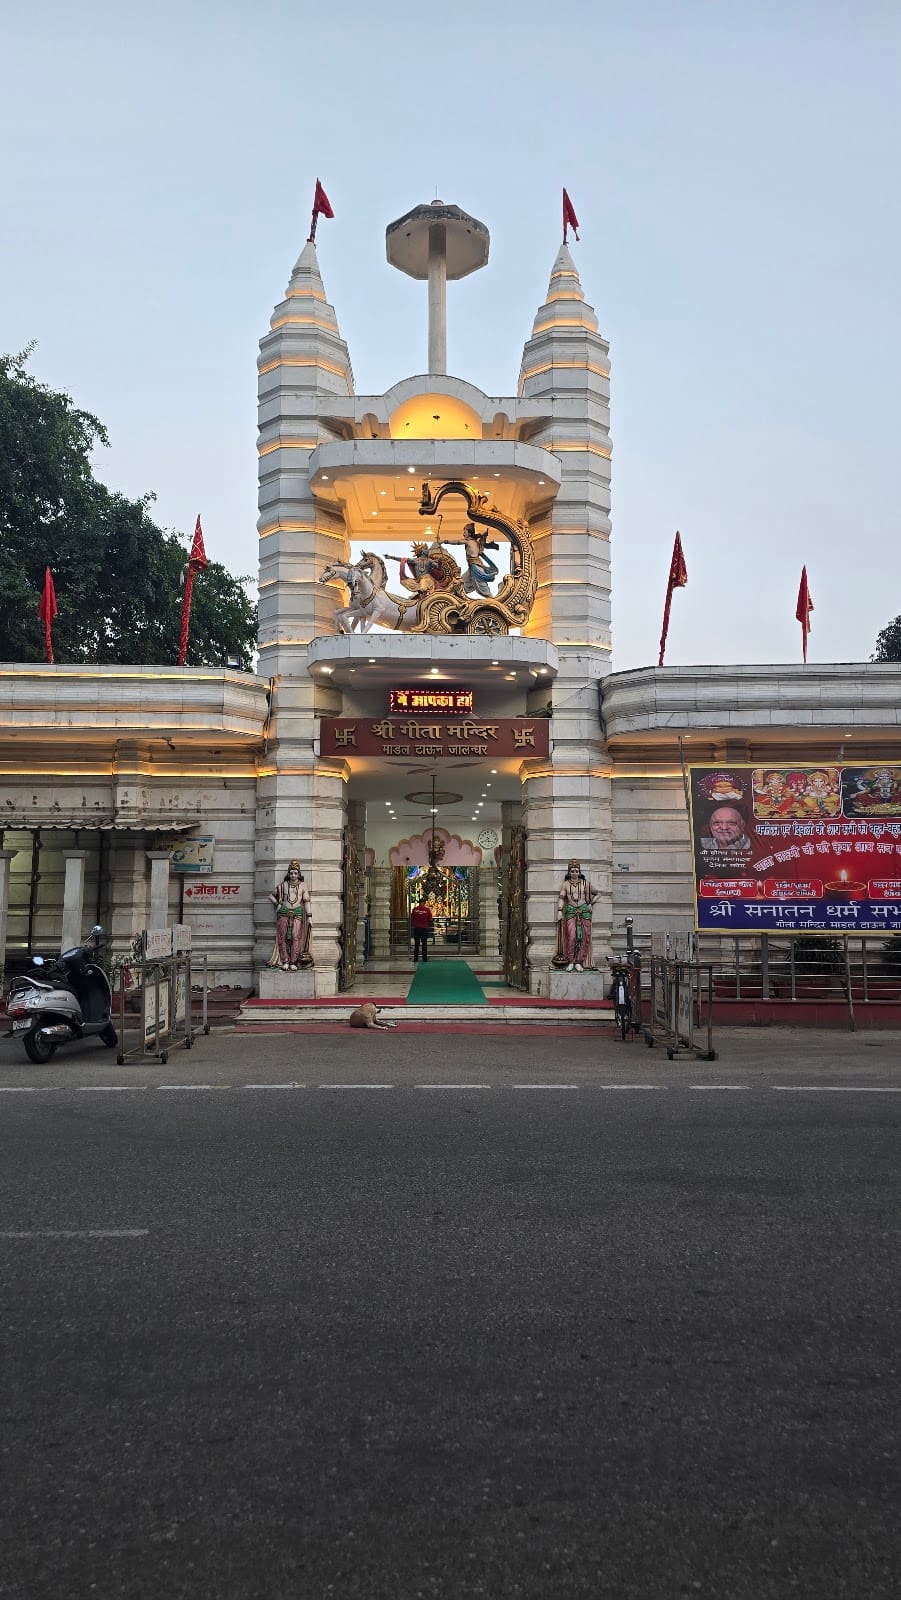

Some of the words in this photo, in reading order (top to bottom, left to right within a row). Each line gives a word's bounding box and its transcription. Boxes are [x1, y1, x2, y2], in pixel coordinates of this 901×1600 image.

[412, 695, 453, 707] आपका
[371, 720, 395, 739] श्री
[400, 720, 442, 739] गीता
[447, 720, 499, 740] मन्दिर
[415, 745, 443, 756] टाऊन
[448, 744, 488, 756] जालन्धर
[221, 885, 240, 895] घर
[709, 901, 736, 917] श्री
[744, 904, 816, 918] सनातन
[826, 901, 861, 918] धर्म
[776, 919, 797, 928] गीता
[799, 919, 827, 929] मन्दिर
[860, 921, 886, 929] टाऊन
